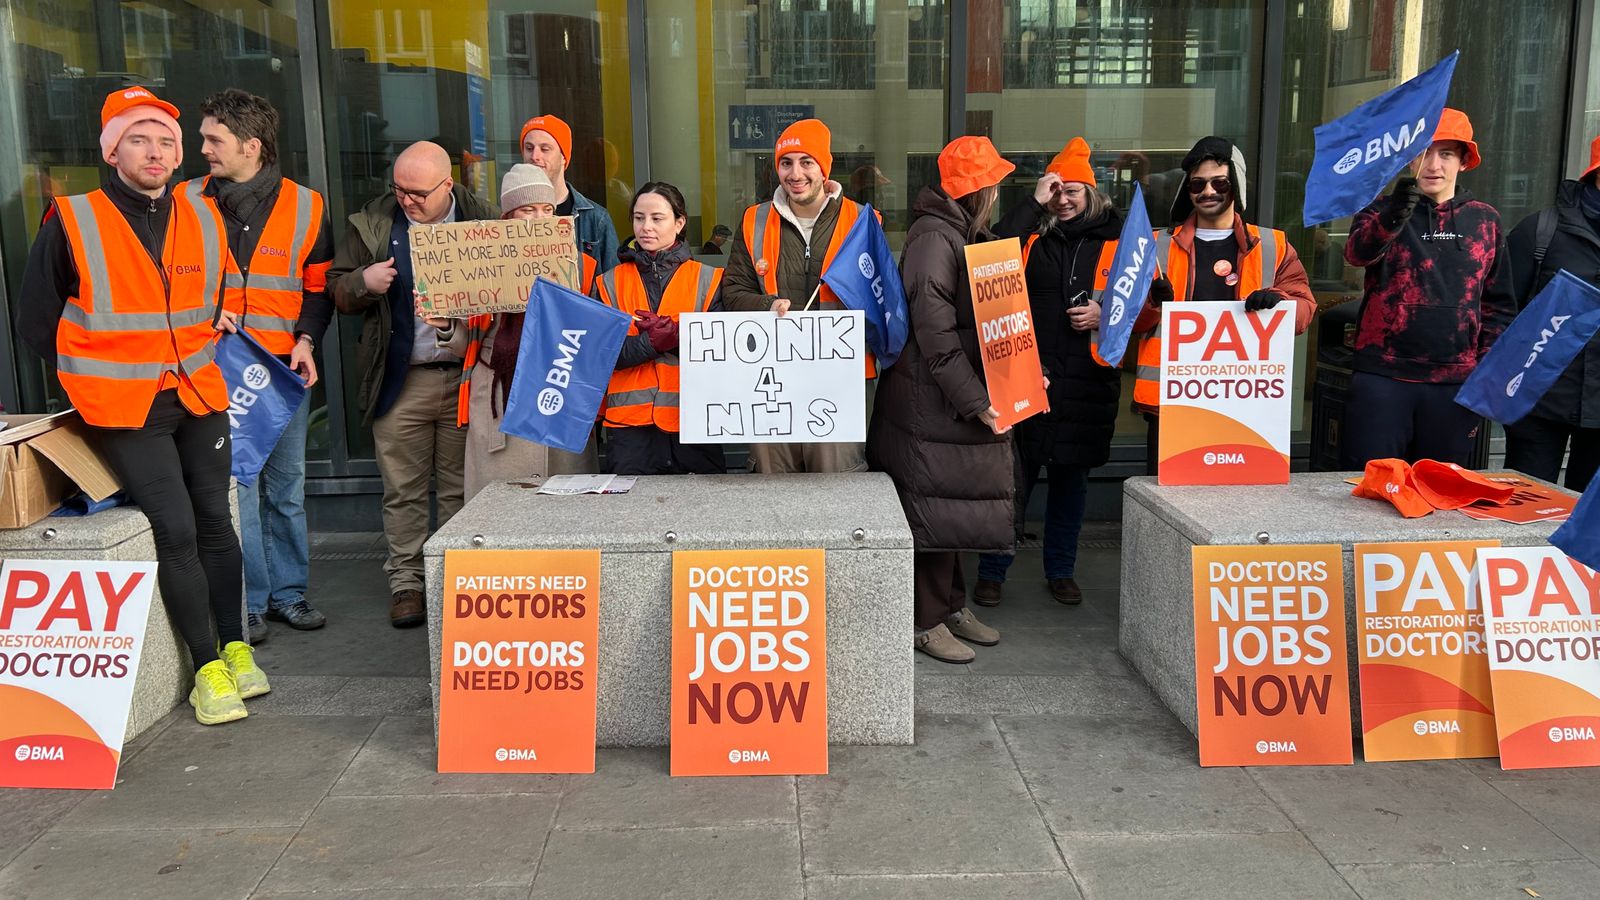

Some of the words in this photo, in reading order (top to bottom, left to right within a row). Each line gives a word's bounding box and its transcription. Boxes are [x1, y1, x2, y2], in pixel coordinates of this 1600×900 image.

[1364, 117, 1426, 165] BMA
[415, 230, 458, 247] EVEN
[464, 226, 500, 241] XMAS
[506, 222, 553, 239] ELVES
[269, 248, 287, 257] BMA
[417, 248, 455, 266] HAVE
[458, 245, 496, 261] MORE
[498, 244, 519, 258] JOB
[522, 242, 574, 257] SECURITY
[184, 264, 201, 273] BMA
[424, 269, 454, 285] WE
[461, 264, 505, 281] WANT
[515, 260, 551, 277] JOBS
[973, 261, 1004, 280] PATIENTS
[1003, 259, 1020, 273] NEED
[1113, 237, 1149, 299] BMA
[434, 287, 502, 310] EMPLOY
[517, 285, 529, 302] U
[975, 273, 1024, 303] DOCTORS
[446, 307, 481, 316] JUVENILE
[486, 303, 528, 313] DELINQUEN
[689, 316, 855, 363] HONK
[981, 310, 1030, 344] DOCTORS
[1168, 309, 1288, 362] PAY
[545, 329, 588, 389] BMA
[985, 342, 1014, 363] NEED
[1013, 332, 1034, 357] JOBS
[1167, 365, 1257, 376] RESTORATION
[1260, 364, 1286, 375] FOR
[754, 367, 783, 402] 4
[1166, 379, 1285, 399] DOCTORS
[227, 386, 258, 430] BM
[707, 398, 838, 437] NHS
[1217, 453, 1245, 464] BMA
[456, 576, 536, 590] PATIENTS
[540, 576, 587, 590] NEED
[689, 565, 810, 588] DOCTORS
[1209, 561, 1328, 583] DOCTORS
[1362, 551, 1481, 613] PAY
[1486, 557, 1600, 618] PAY
[0, 570, 146, 632] PAY
[455, 593, 586, 619] DOCTORS
[688, 591, 810, 628] NEED
[1210, 586, 1329, 622] NEED
[1365, 615, 1464, 629] RESTORATION
[1468, 614, 1485, 627] FO
[1493, 620, 1591, 635] RESTORATION
[0, 634, 99, 649] RESTORATION
[103, 636, 134, 650] FOR
[453, 640, 585, 667] DOCTORS
[1213, 625, 1332, 674] JOBS
[1495, 637, 1600, 663] DOCTO
[688, 631, 811, 681] JOBS
[453, 671, 520, 691] NEED
[524, 670, 584, 694] JOBS
[688, 681, 810, 725] NOW
[1213, 675, 1333, 717] NOW
[1429, 720, 1461, 733] BMA
[1564, 727, 1596, 741] BMA
[31, 747, 65, 761] BMA
[509, 749, 537, 761] BMA
[742, 750, 770, 762] BMA
[1269, 741, 1297, 753] BMA
